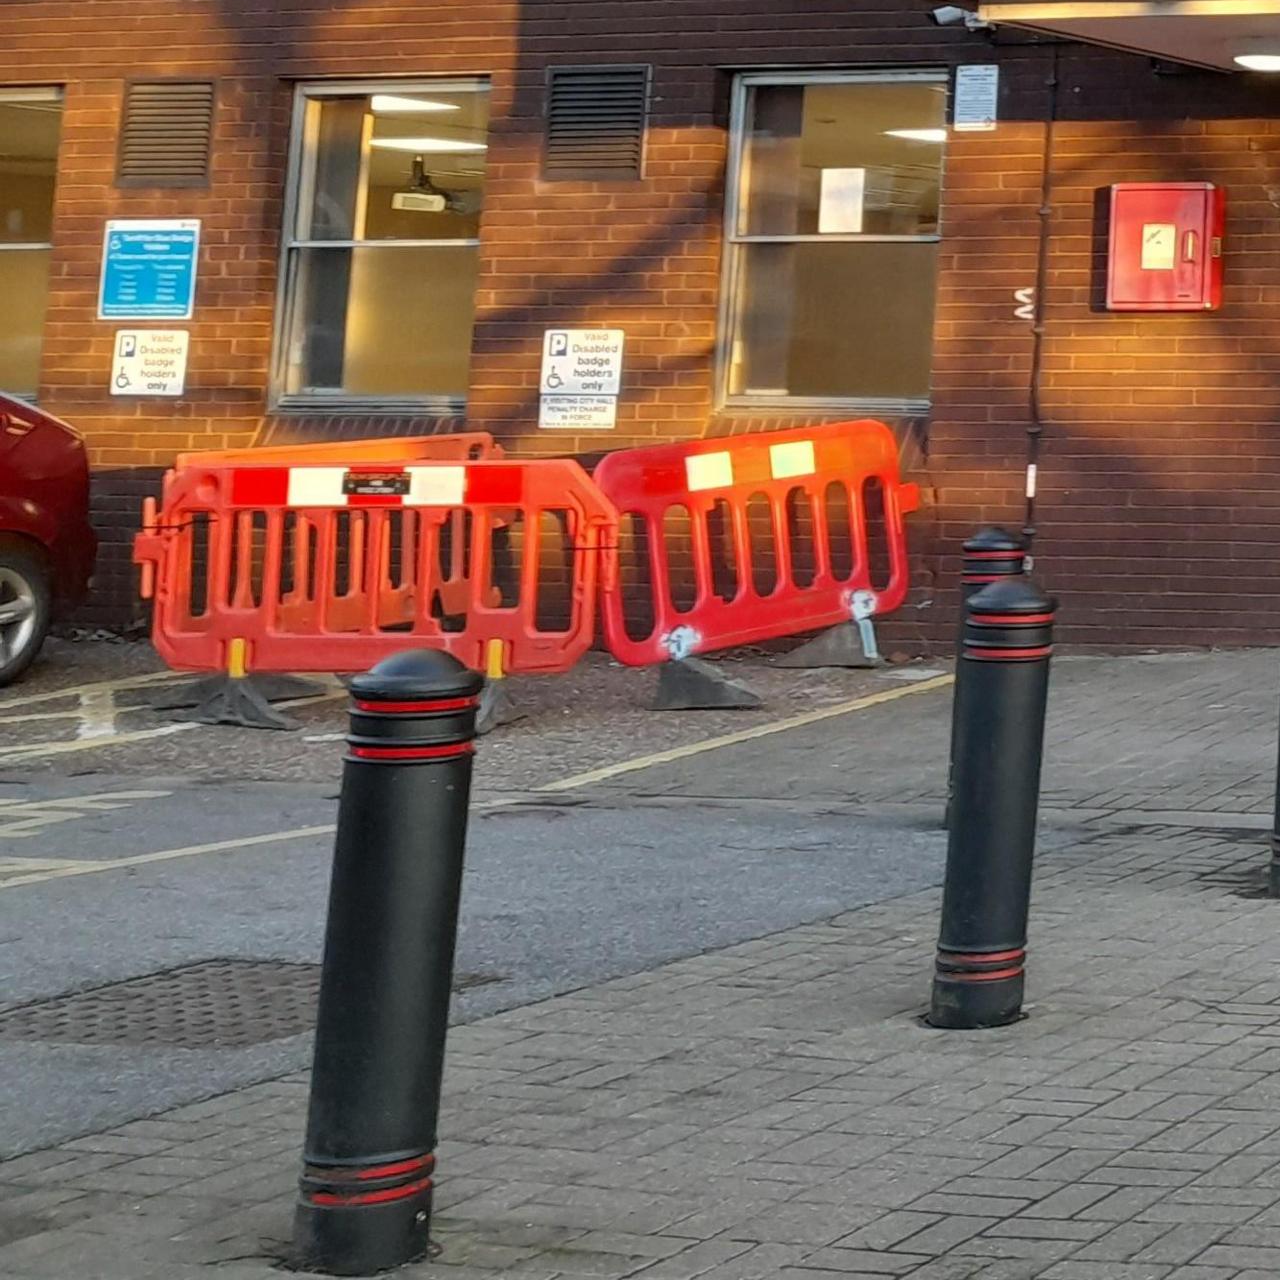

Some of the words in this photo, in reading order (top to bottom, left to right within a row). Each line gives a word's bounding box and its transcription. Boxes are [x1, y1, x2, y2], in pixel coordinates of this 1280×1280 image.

[151, 334, 174, 342] Valid
[584, 333, 609, 341] Valid
[140, 345, 182, 355] Disabled
[572, 344, 618, 353] Disabled
[144, 357, 175, 368] badge
[577, 357, 611, 367] badge
[140, 370, 177, 378] holders
[572, 369, 613, 378] holders
[147, 381, 168, 391] only
[581, 381, 604, 391] only
